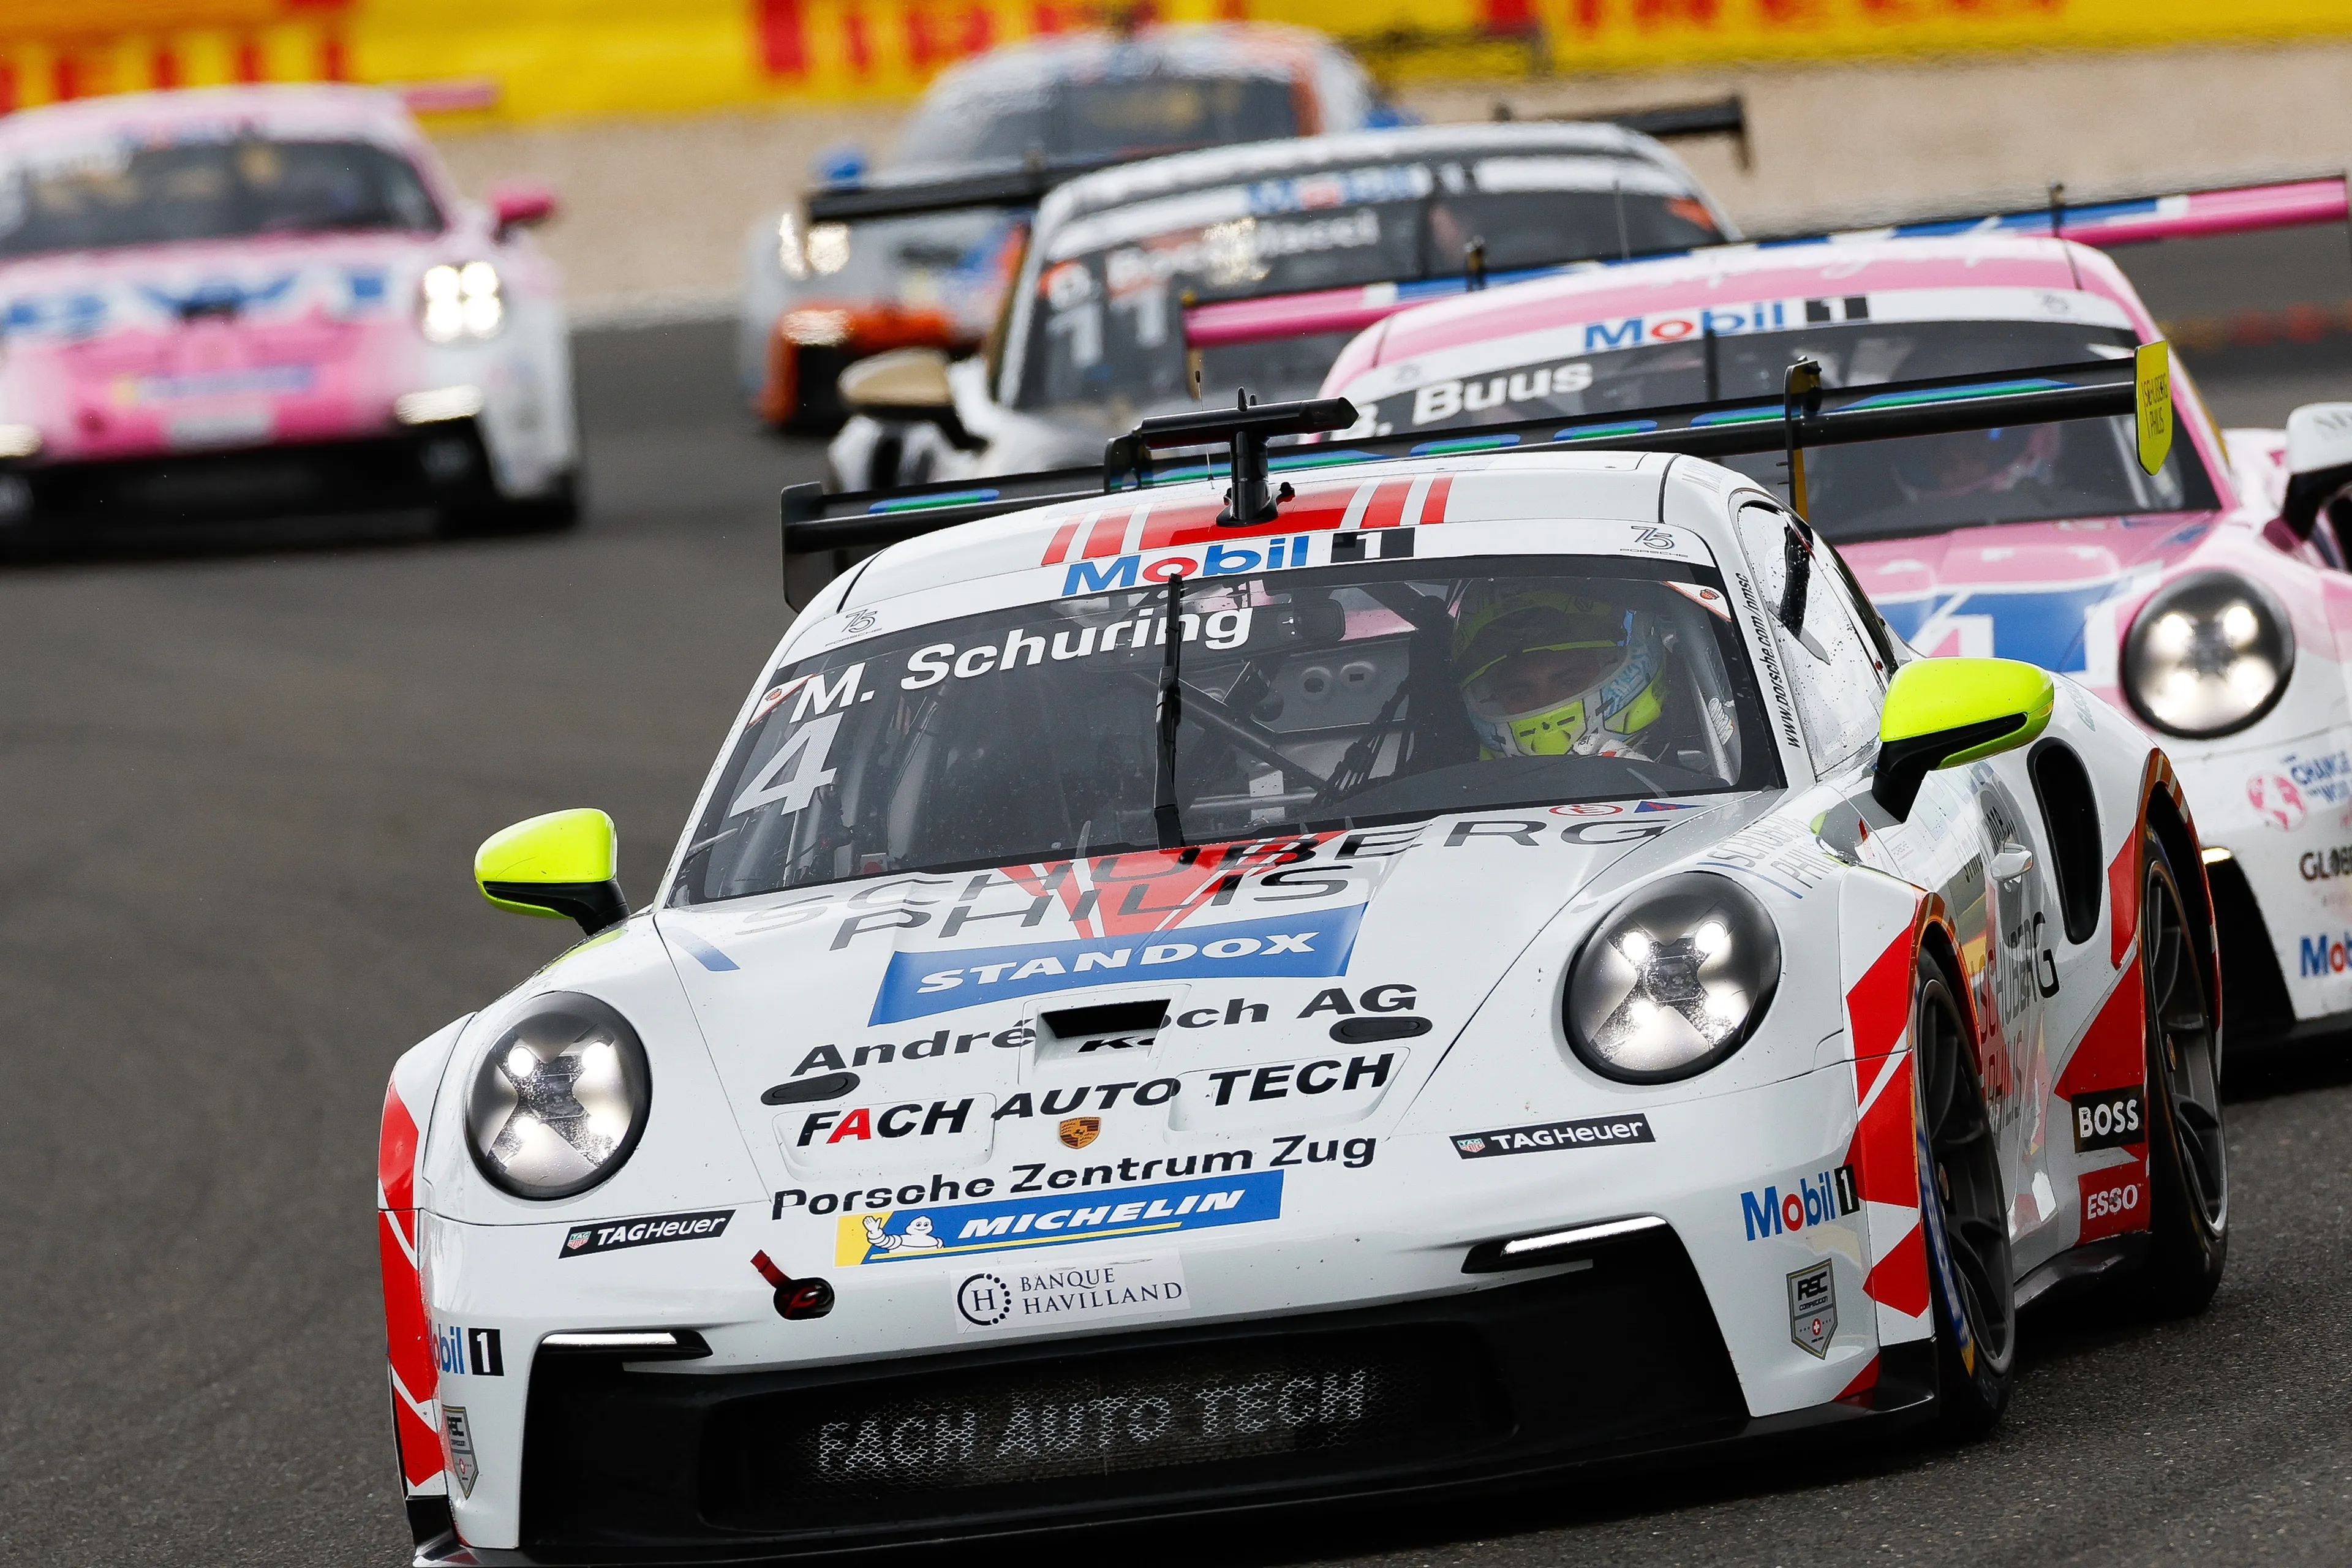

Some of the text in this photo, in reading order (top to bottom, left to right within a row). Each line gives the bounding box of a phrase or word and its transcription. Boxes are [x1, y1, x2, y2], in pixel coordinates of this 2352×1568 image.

[1584, 301, 1783, 353] Mobil
[1412, 362, 1594, 427] Buus
[1061, 535, 1310, 597] Mobil
[1630, 526, 1676, 550] 75
[841, 608, 878, 633] 75
[789, 606, 1253, 724] M. Schuring
[728, 711, 845, 818] 4
[829, 865, 1352, 951] PHILIS
[916, 932, 1320, 994] STANDOX
[790, 1018, 1037, 1077] André
[1295, 984, 1418, 1019] AG
[796, 1052, 1395, 1147] FACH AUTO TECH
[2078, 1099, 2139, 1138] BOSS
[772, 1134, 1378, 1220] Porsche Zentrum Zug
[1740, 1170, 1836, 1242] Mobil
[2087, 1184, 2138, 1220] ESSO
[957, 1189, 1246, 1239] MICHELIN
[1020, 1267, 1115, 1292] BANQUE
[1022, 1281, 1183, 1315] HAVILLAND
[818, 1368, 1366, 1471] FACH AUTO TECH
